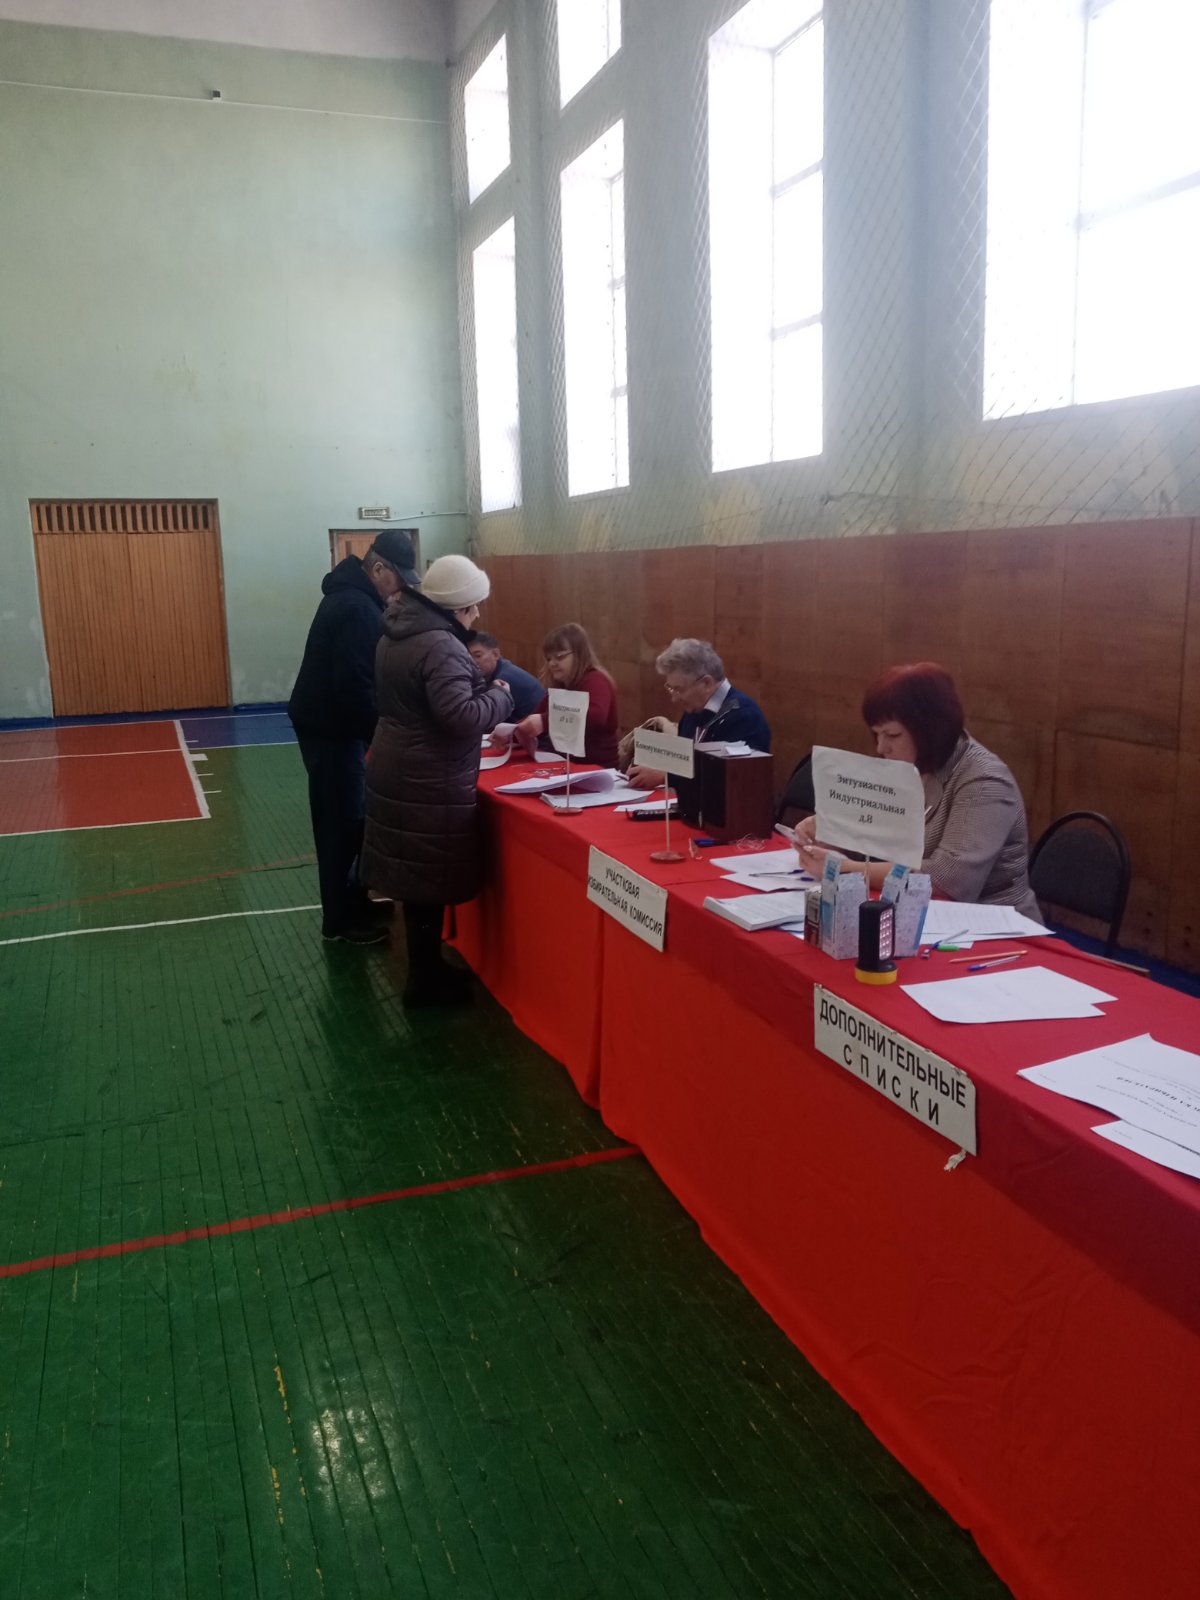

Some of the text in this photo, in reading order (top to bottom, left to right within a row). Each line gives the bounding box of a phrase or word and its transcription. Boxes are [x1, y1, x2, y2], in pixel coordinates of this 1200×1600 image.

[836, 774, 897, 796] Энтузиастов,
[828, 789, 906, 815] Индустриальная
[605, 867, 640, 900] УЧАСТКОВАЯ
[629, 905, 663, 936] КОМИССИЯ
[820, 999, 967, 1108] ДОПОЛНИТЕЛЬНЫЕ
